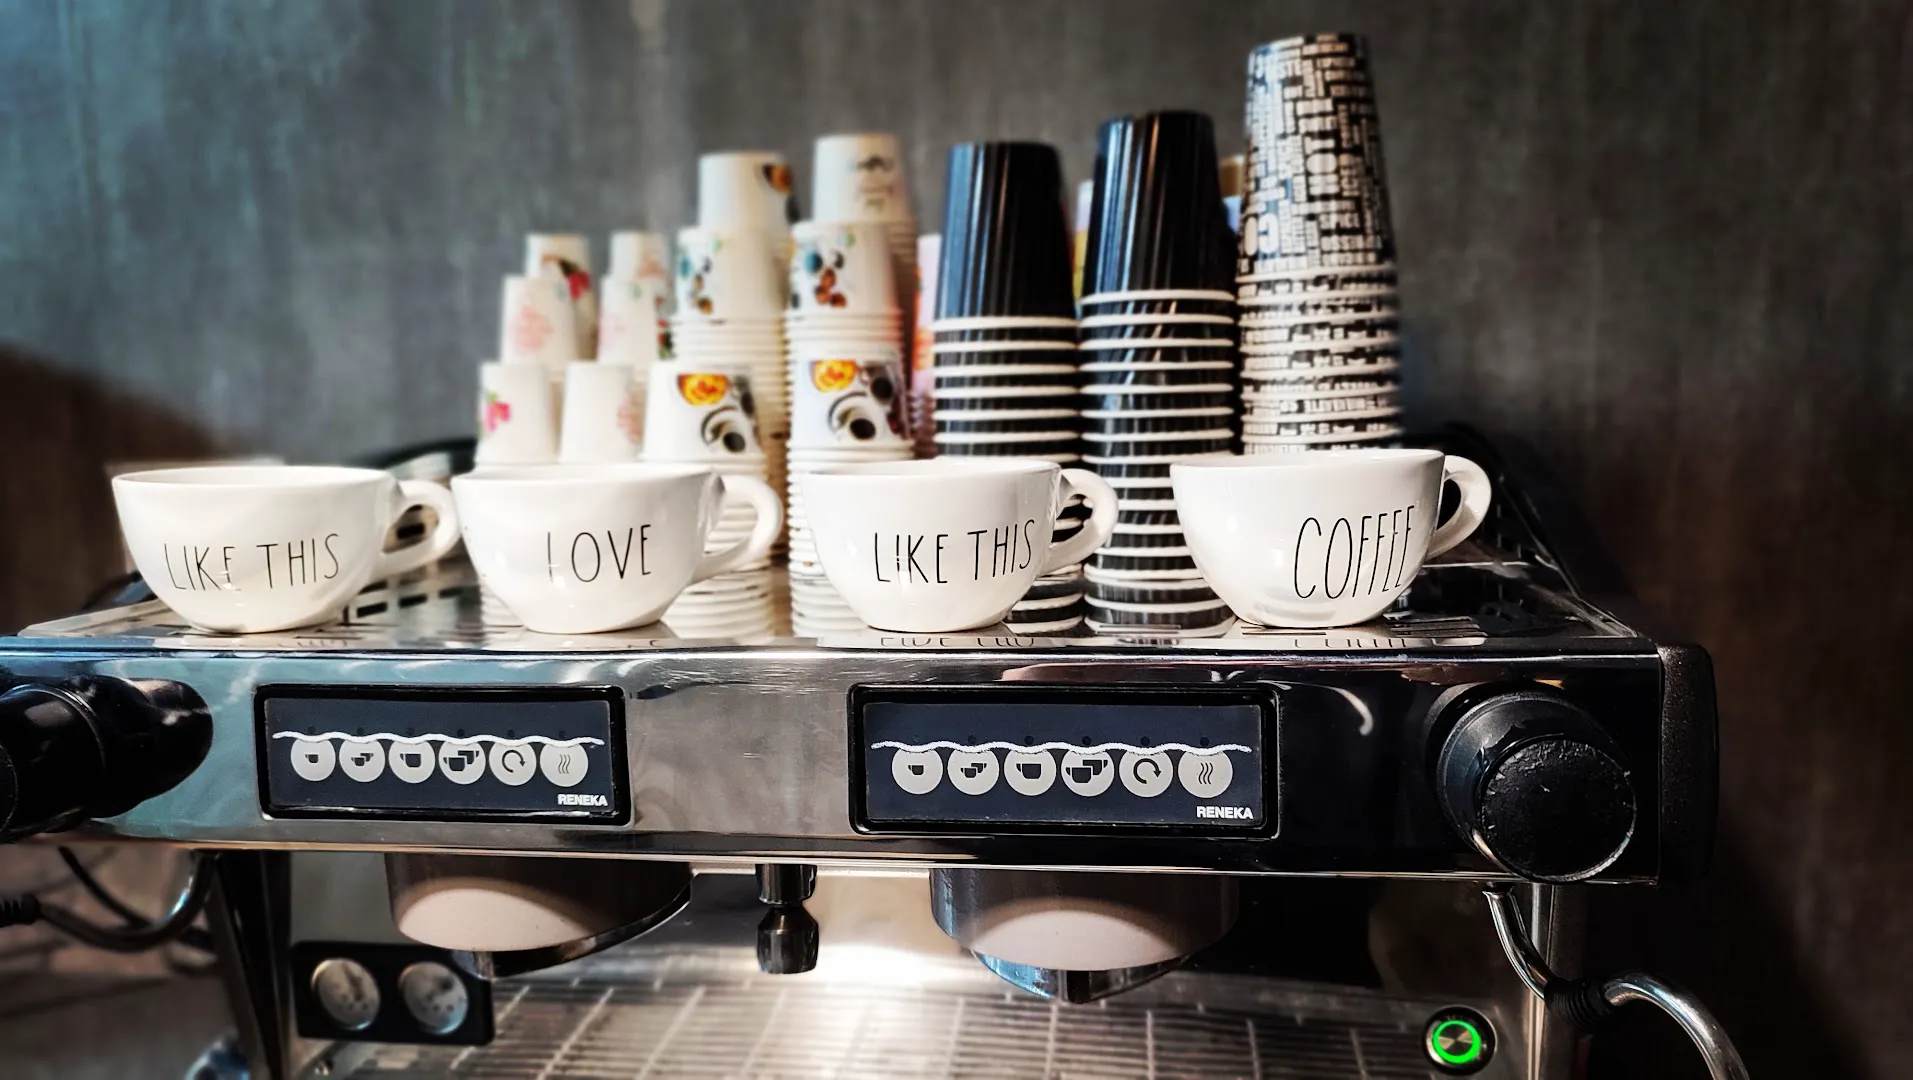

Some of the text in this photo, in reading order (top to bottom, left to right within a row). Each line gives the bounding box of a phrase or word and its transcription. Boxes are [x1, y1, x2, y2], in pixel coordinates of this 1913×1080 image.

[163, 533, 340, 591] LIKE THIS
[547, 524, 652, 583] LOVE
[874, 518, 1036, 584] LIKE THIS
[1293, 504, 1415, 600] COFFEE
[557, 793, 608, 807] RENEKA
[1196, 806, 1254, 821] RENEKA
